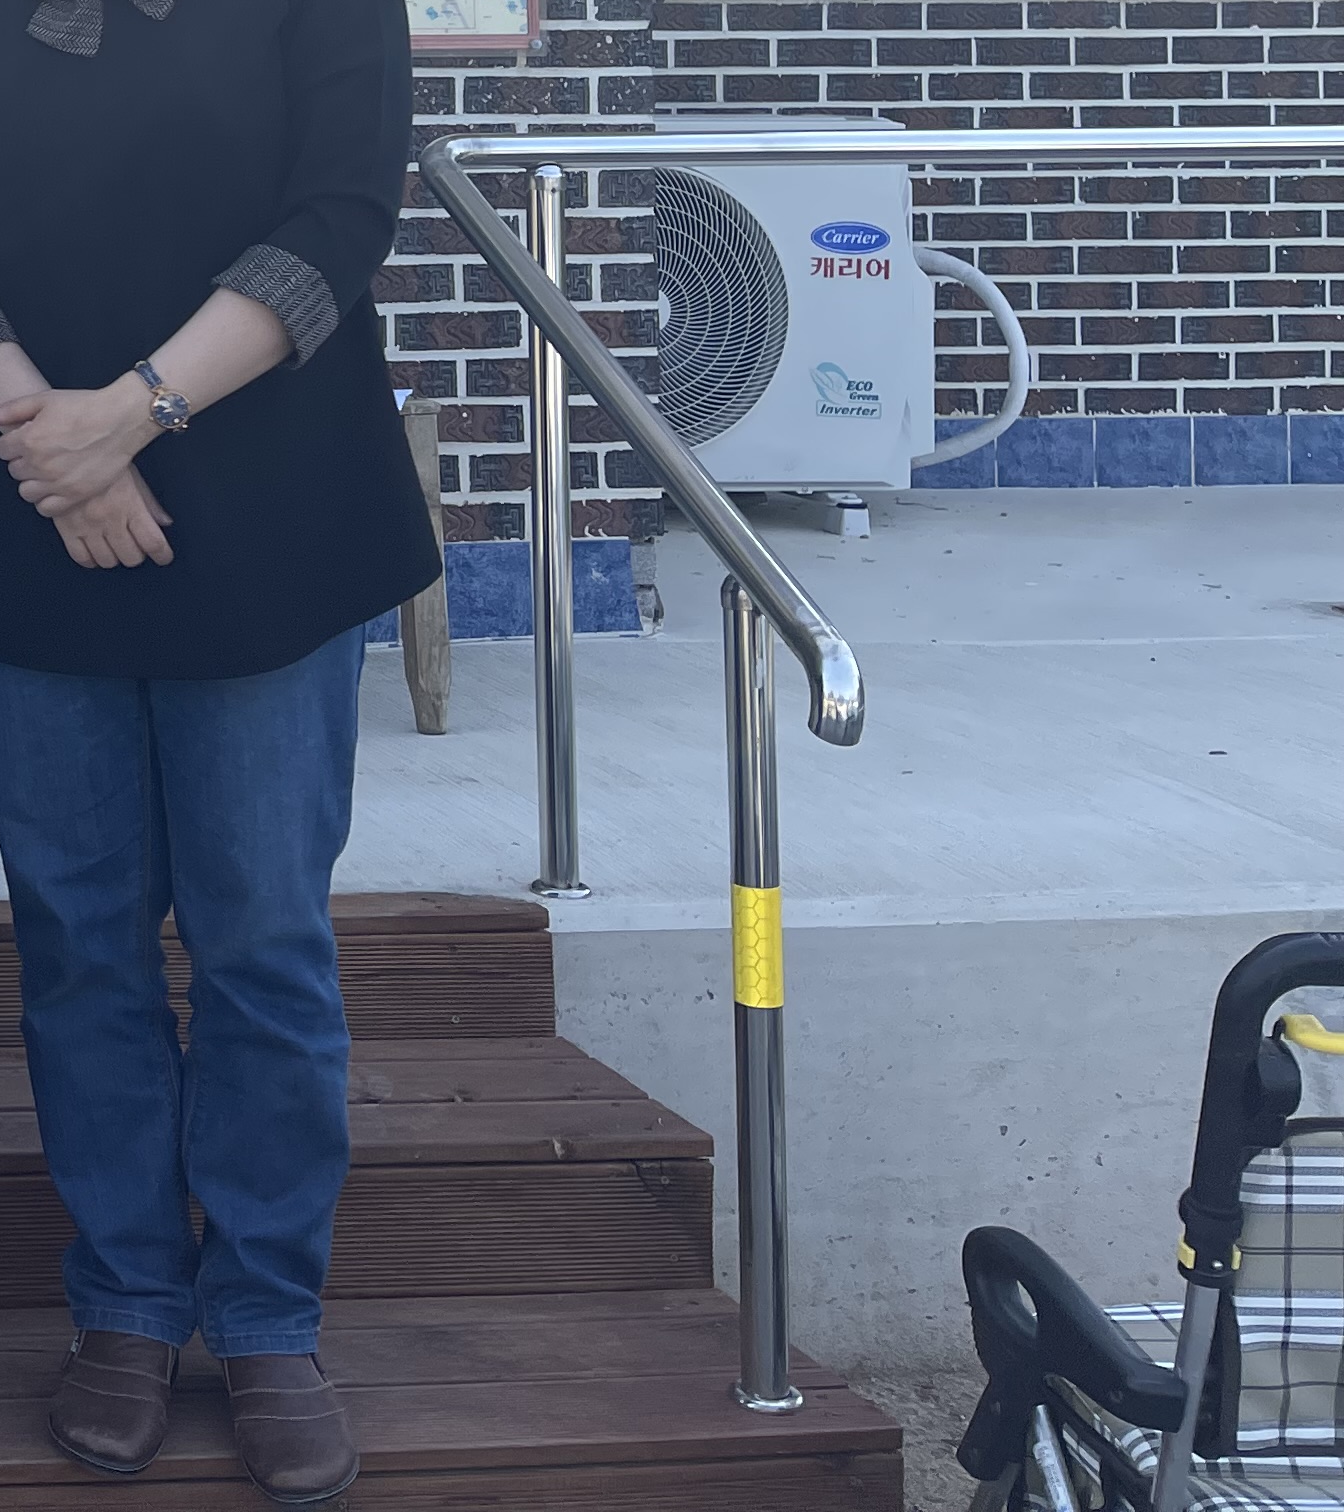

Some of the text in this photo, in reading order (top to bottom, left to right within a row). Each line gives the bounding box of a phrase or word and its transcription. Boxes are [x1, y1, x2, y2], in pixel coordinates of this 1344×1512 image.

[822, 228, 880, 245] Carrier
[810, 256, 890, 280] 캐리어
[846, 380, 873, 392] ECO
[849, 391, 879, 401] Green
[820, 403, 878, 416] Inverter
